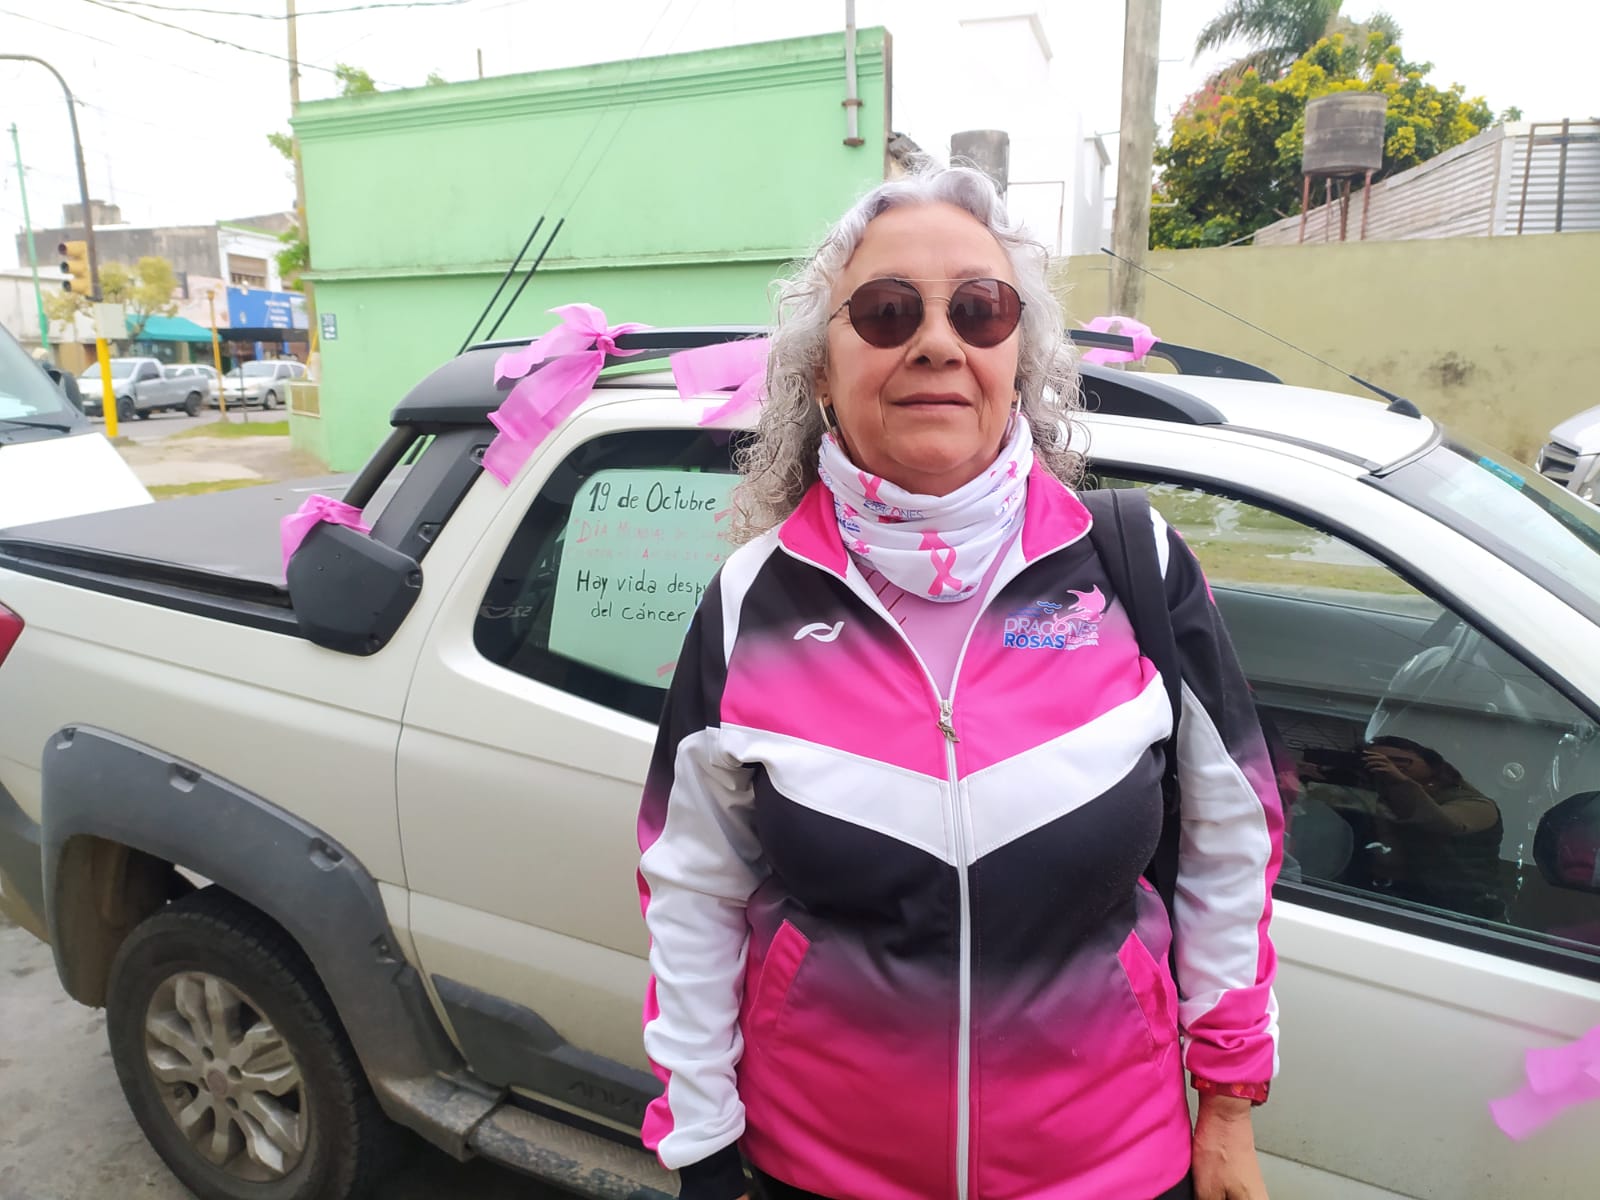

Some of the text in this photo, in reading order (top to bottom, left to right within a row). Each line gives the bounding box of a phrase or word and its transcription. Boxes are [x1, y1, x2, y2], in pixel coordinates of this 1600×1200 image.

[589, 482, 716, 513] 19 de Octubre
[577, 569, 608, 600] Hay
[617, 568, 657, 594] vida
[591, 601, 686, 622] del cáncer
[1004, 632, 1065, 649] ROSAS
